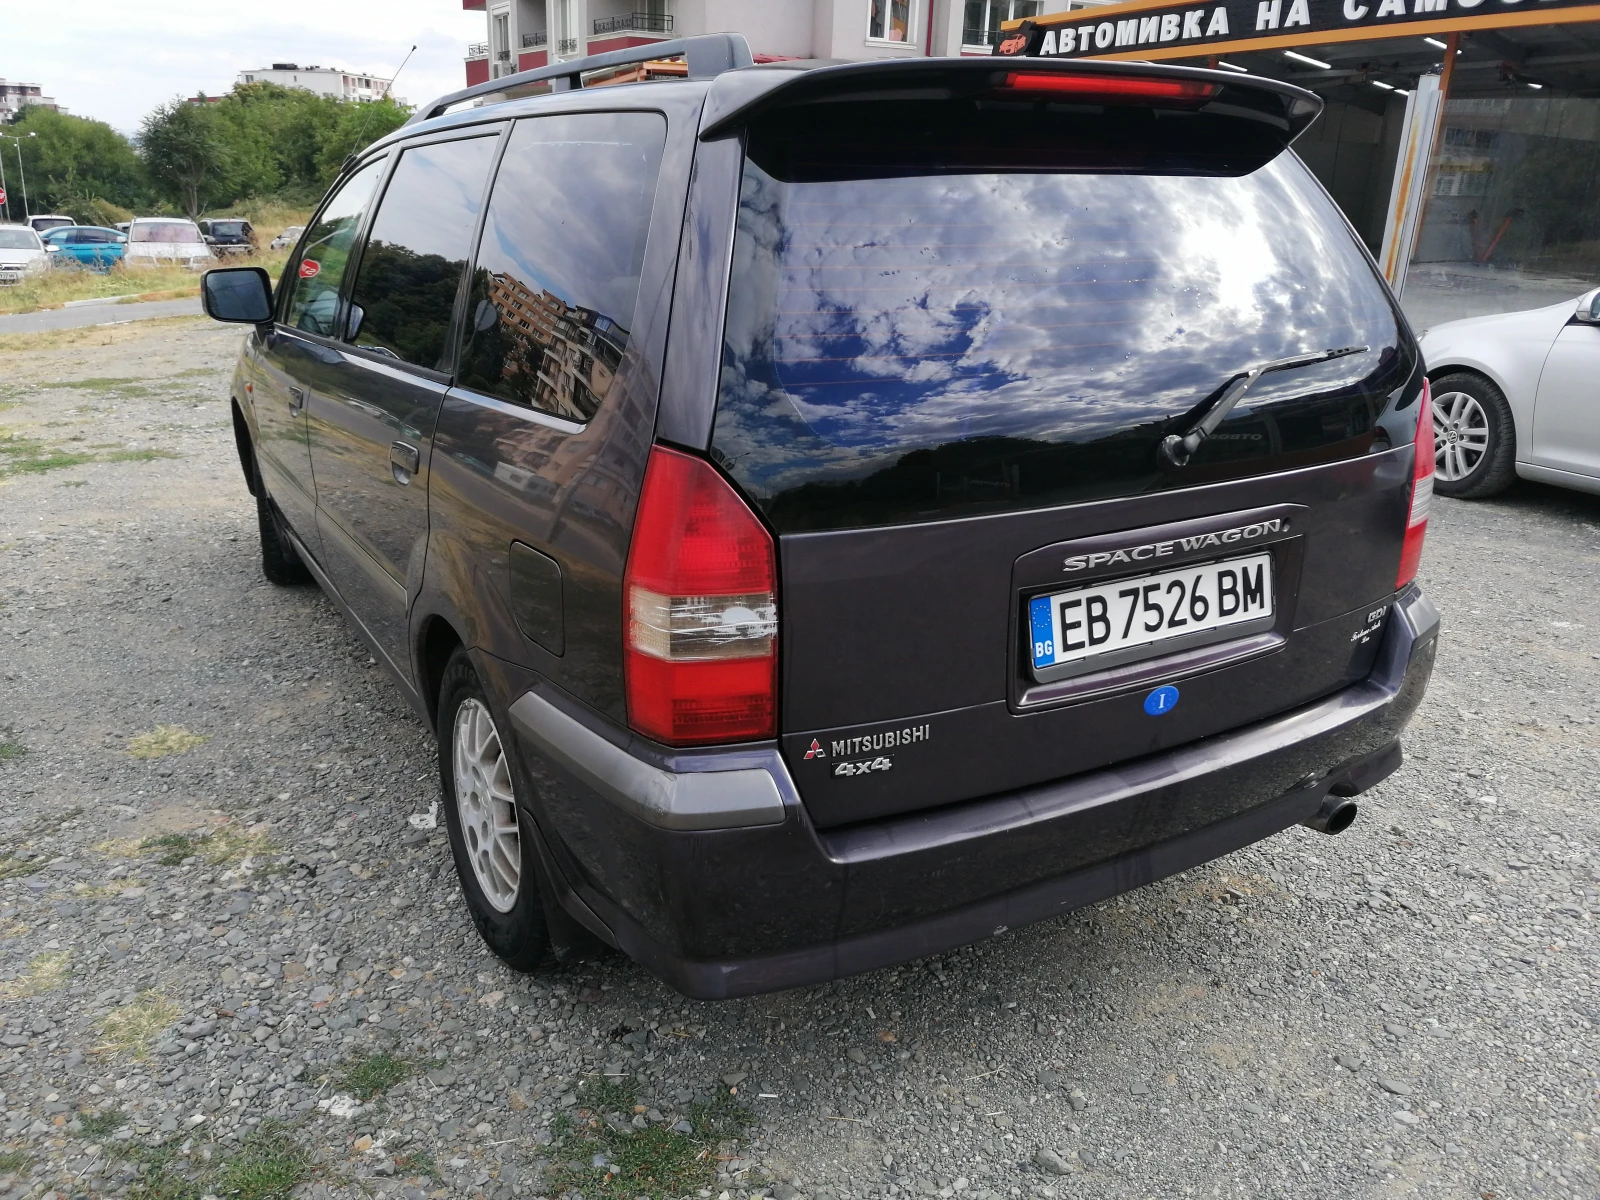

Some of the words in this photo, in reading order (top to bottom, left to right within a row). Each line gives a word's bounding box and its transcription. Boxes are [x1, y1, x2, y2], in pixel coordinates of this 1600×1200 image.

[1040, 6, 1230, 56] АВТОМИВКА
[1255, 0, 1311, 31] НА
[1063, 541, 1175, 572] SPACE
[1178, 518, 1281, 552] WAGON
[1118, 574, 1210, 640] 7526
[1035, 640, 1053, 658] BG
[831, 724, 930, 757] MITSUBISHI
[834, 757, 893, 776] 4x4
